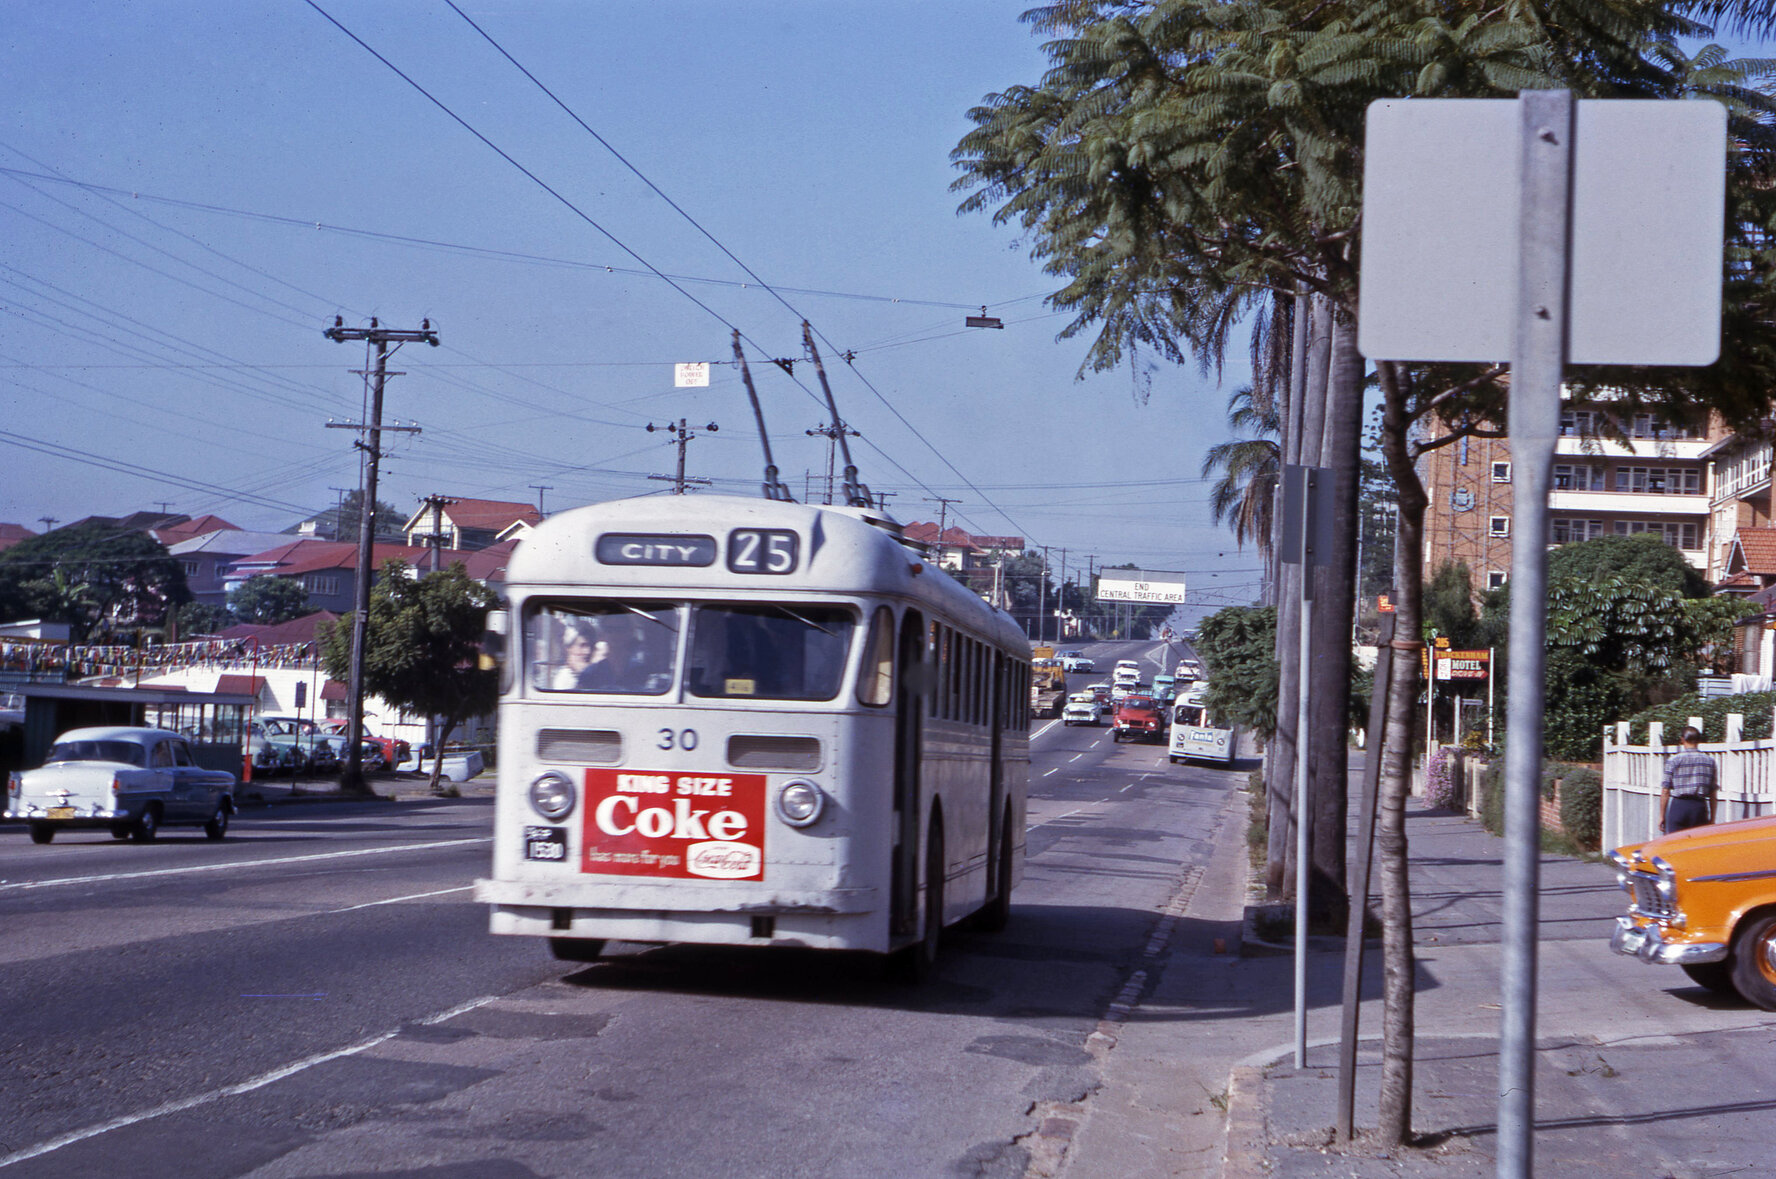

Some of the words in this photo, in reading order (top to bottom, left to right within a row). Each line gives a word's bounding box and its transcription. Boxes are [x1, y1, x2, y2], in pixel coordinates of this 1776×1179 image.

[621, 543, 698, 560] CITY
[736, 532, 791, 572] 25
[1101, 590, 1131, 599] CENTRAL
[1134, 591, 1162, 601] TRAFFIC
[1164, 593, 1183, 601] AREA
[1134, 583, 1150, 591] END
[1452, 660, 1482, 670] MOTEL
[657, 728, 698, 751] 30
[617, 774, 670, 793] KING
[676, 777, 732, 796] SIZE
[595, 795, 748, 840] Coke
